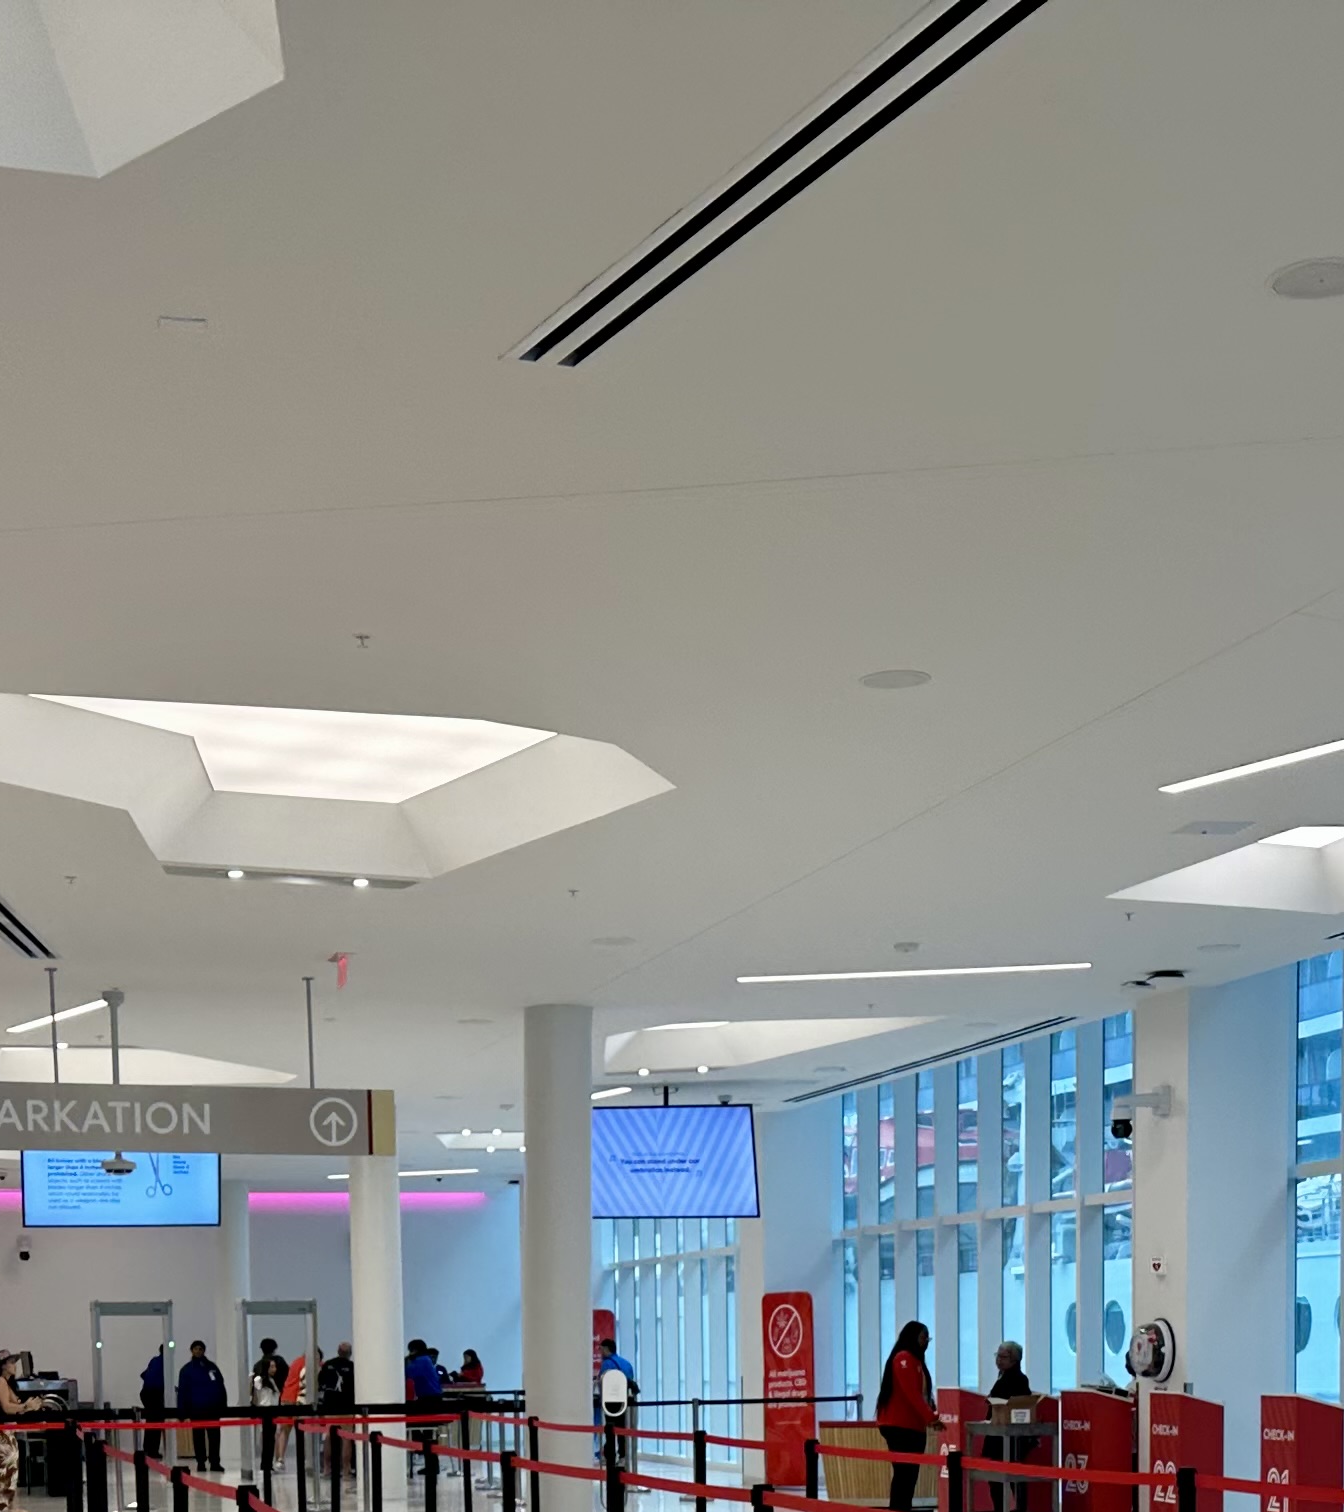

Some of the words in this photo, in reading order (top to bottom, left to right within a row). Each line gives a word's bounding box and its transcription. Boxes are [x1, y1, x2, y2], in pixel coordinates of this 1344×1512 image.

[1063, 1419, 1091, 1431] CHECK-IN
[1152, 1423, 1178, 1436] CHECK-IN
[1263, 1428, 1295, 1441] CHECK-IN
[1065, 1453, 1089, 1493] 23
[1153, 1460, 1177, 1503] 22
